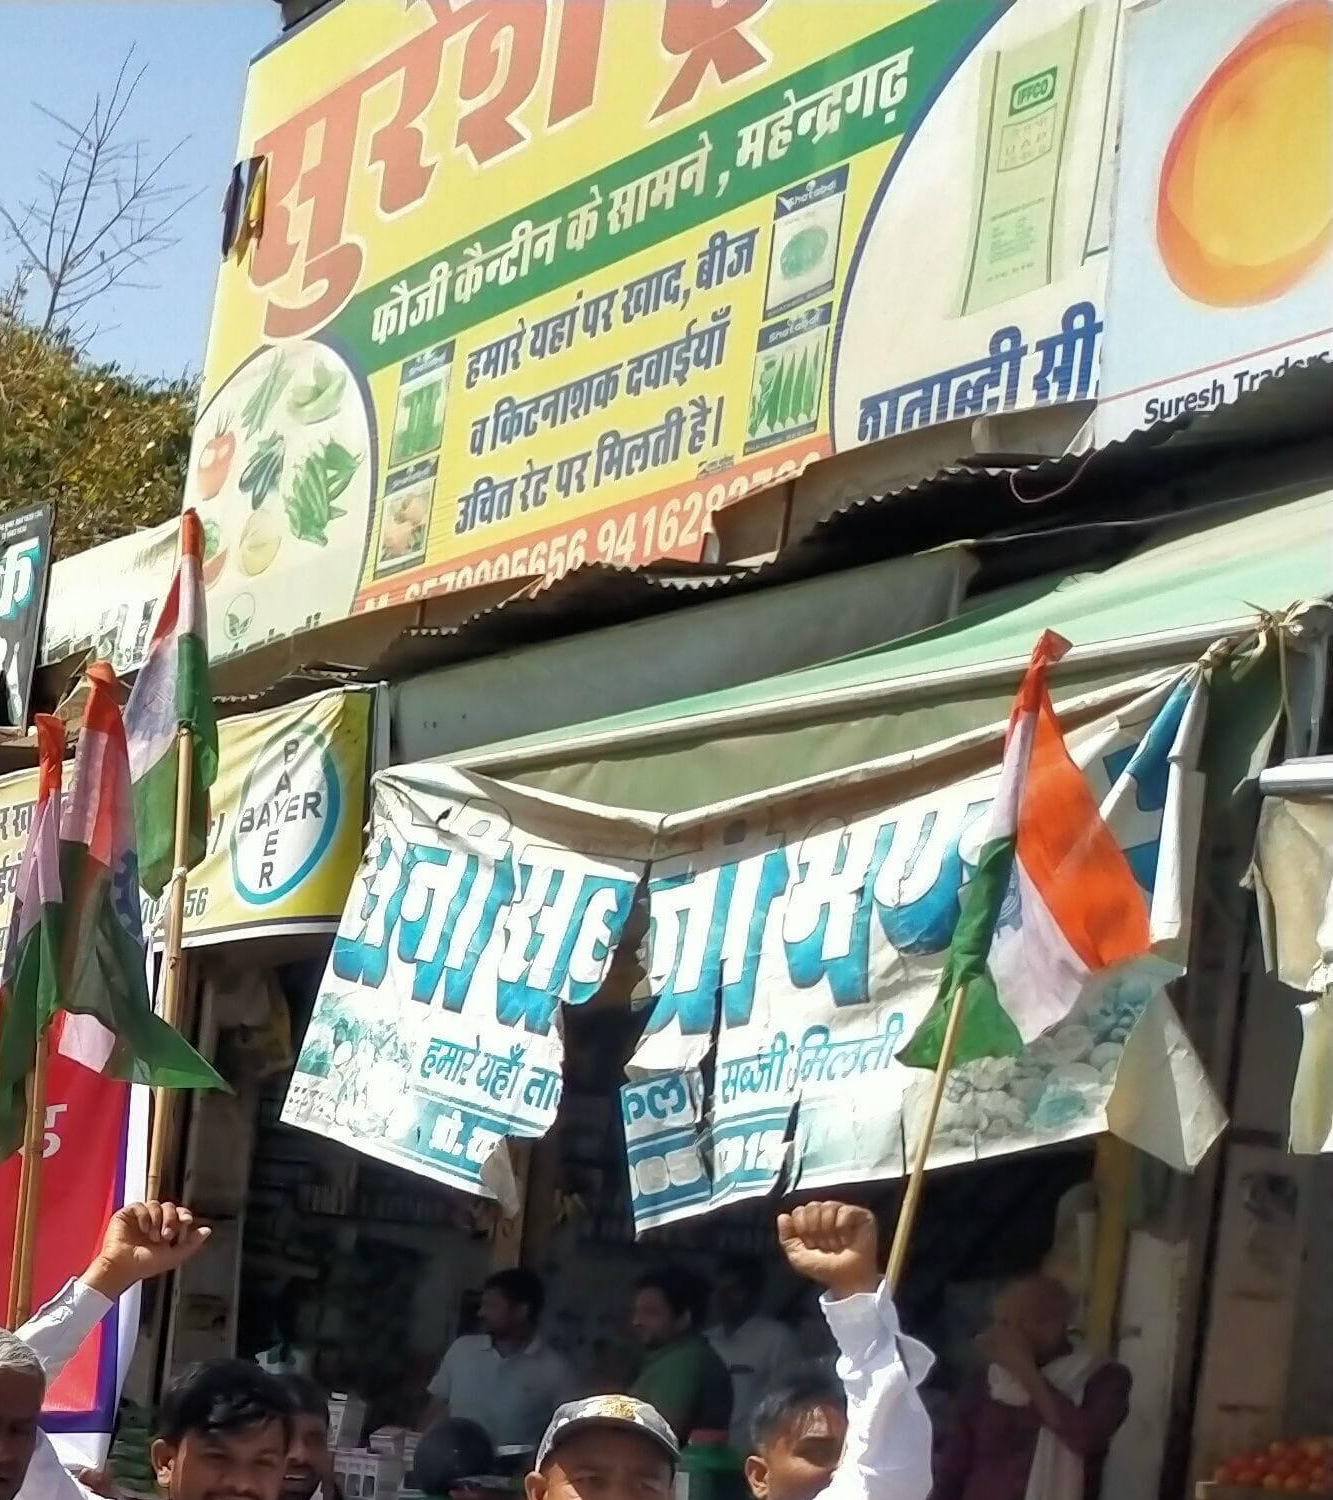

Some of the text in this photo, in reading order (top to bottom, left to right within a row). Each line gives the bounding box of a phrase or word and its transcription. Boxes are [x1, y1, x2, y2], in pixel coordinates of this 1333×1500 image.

[1017, 77, 1049, 106] IFFCO
[370, 262, 451, 345] फौजी
[565, 185, 603, 253] के
[466, 318, 527, 390] हमारे
[581, 298, 619, 337] पर
[696, 227, 761, 291] बीज
[1144, 379, 1225, 424] Suresh
[470, 415, 490, 456] व
[454, 476, 516, 537] उचित
[517, 461, 550, 515] रेट
[556, 451, 592, 499] पर
[593, 414, 687, 488] मिलती
[238, 791, 323, 834] BAYER
